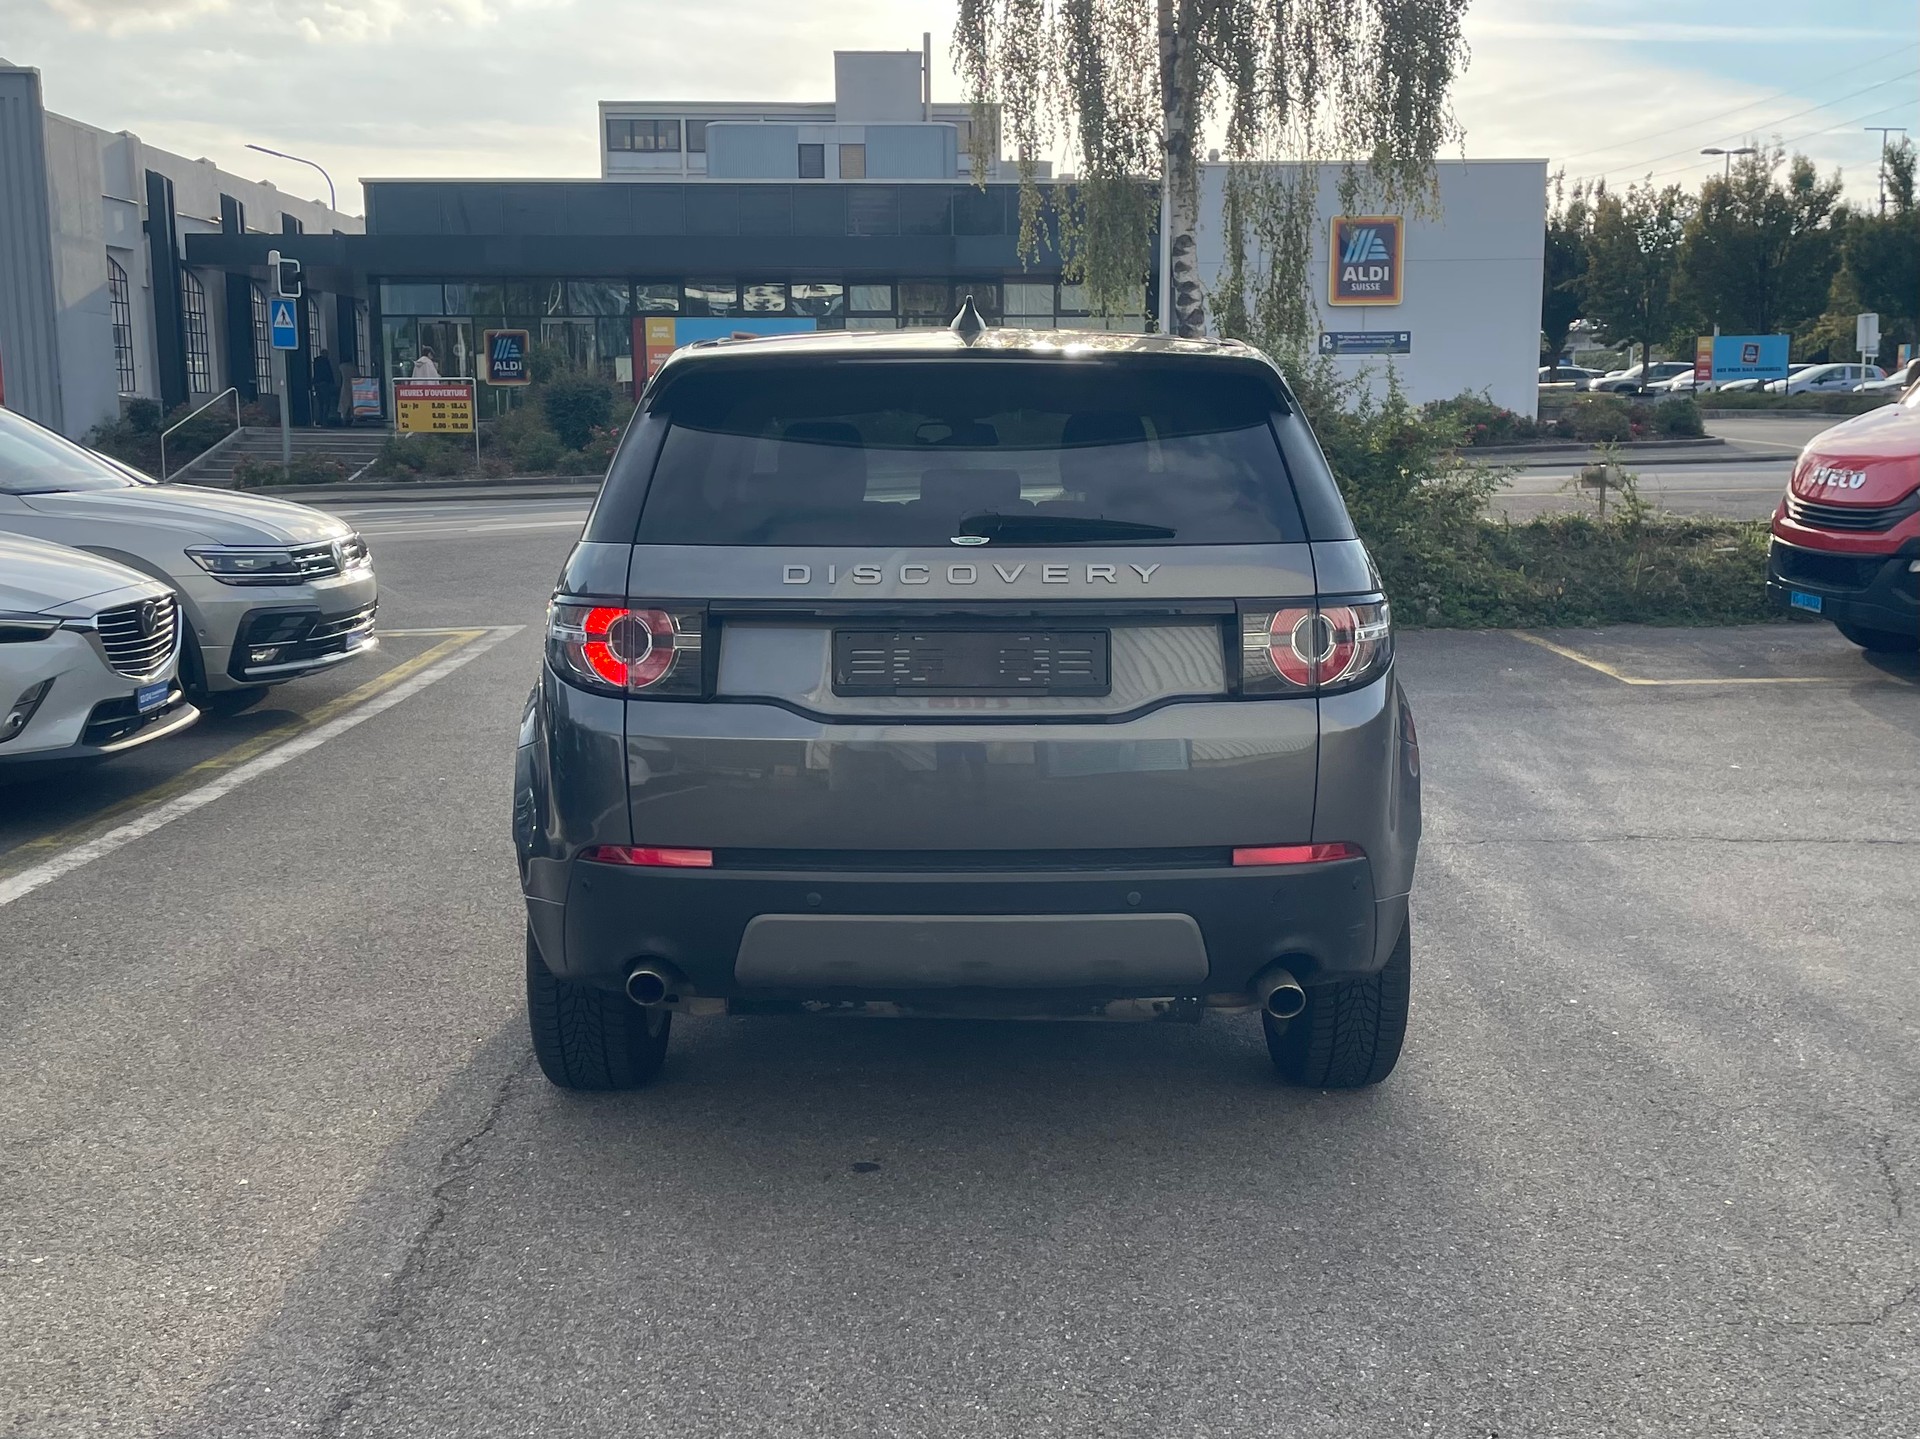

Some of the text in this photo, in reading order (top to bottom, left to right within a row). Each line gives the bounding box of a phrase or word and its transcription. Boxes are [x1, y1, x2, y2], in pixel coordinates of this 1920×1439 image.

[1342, 266, 1389, 281] ALDI
[1351, 282, 1381, 291] SUISSE
[494, 361, 522, 370] ALDI
[400, 389, 468, 397] HEURES D'OUVERTURE
[1811, 467, 1867, 489] IVECO
[782, 563, 1161, 585] DISCOVERY
